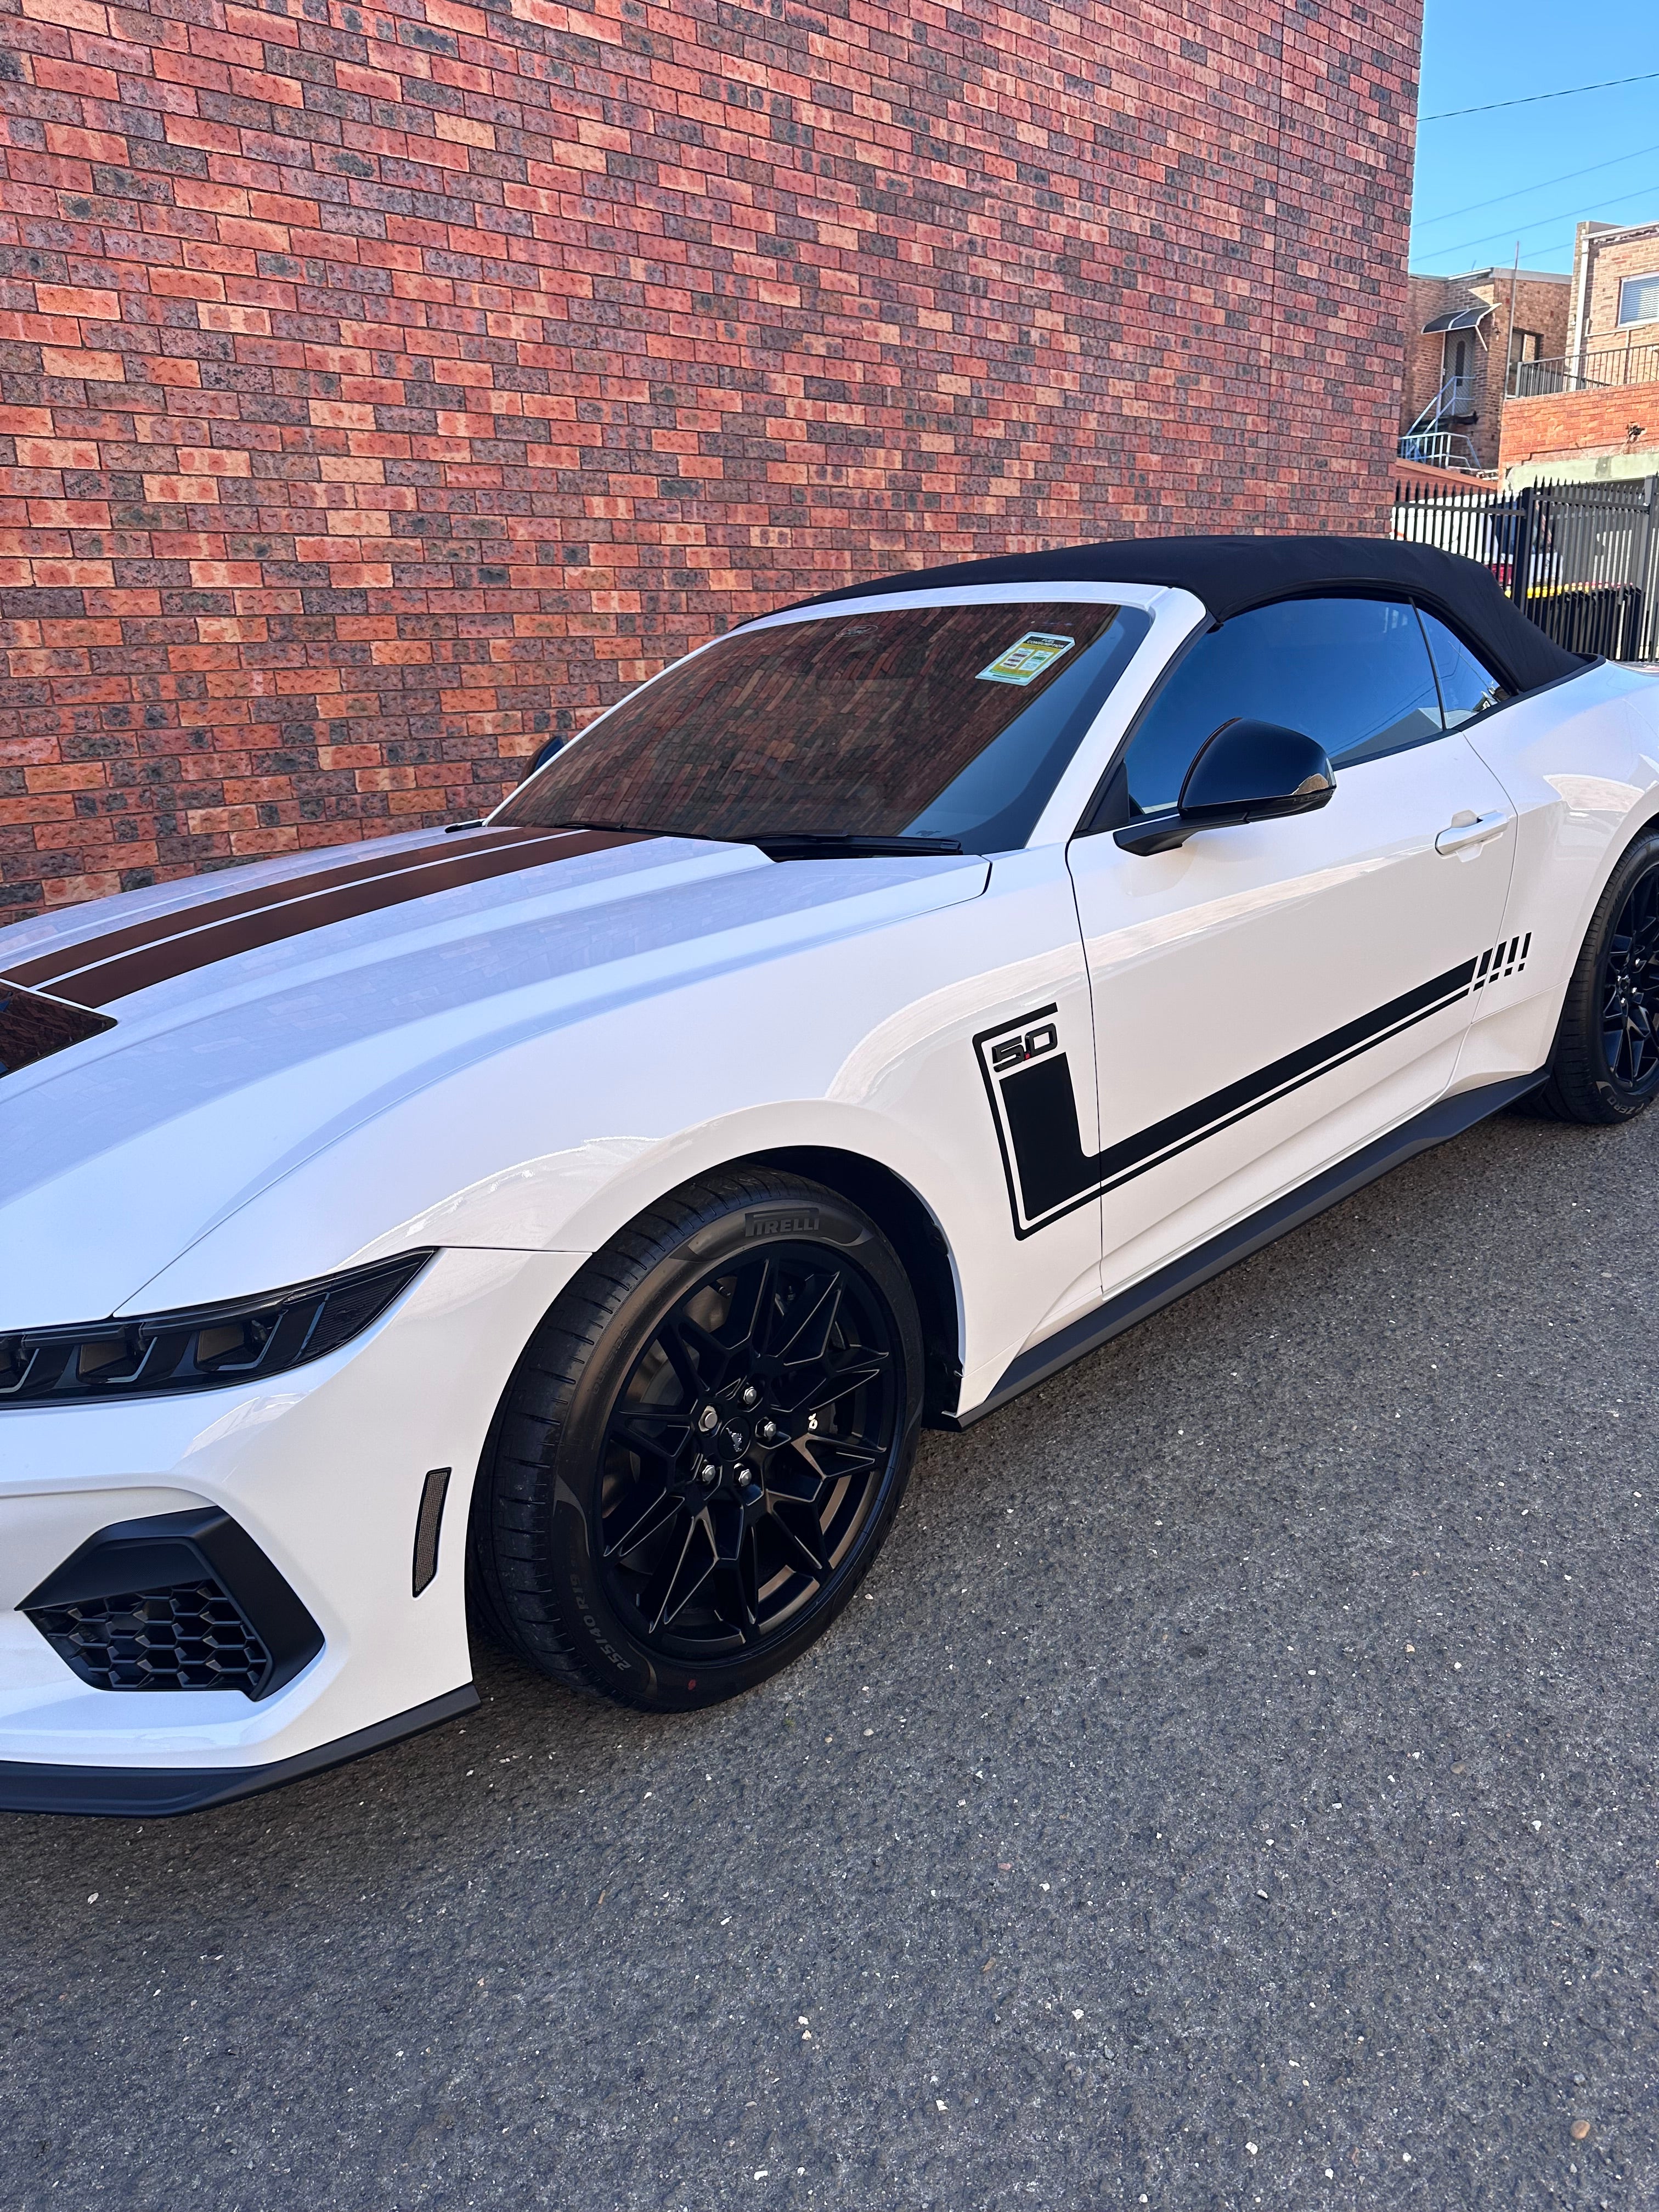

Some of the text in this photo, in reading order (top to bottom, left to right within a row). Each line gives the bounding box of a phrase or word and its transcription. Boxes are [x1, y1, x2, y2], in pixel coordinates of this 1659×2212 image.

[1026, 640, 1065, 648] CONSUMPTION
[991, 1023, 1058, 1073] 5.0
[1606, 1095, 1636, 1115] ZERO
[744, 1207, 820, 1238] PIRELLI
[569, 1573, 631, 1671] 255/40 R19
